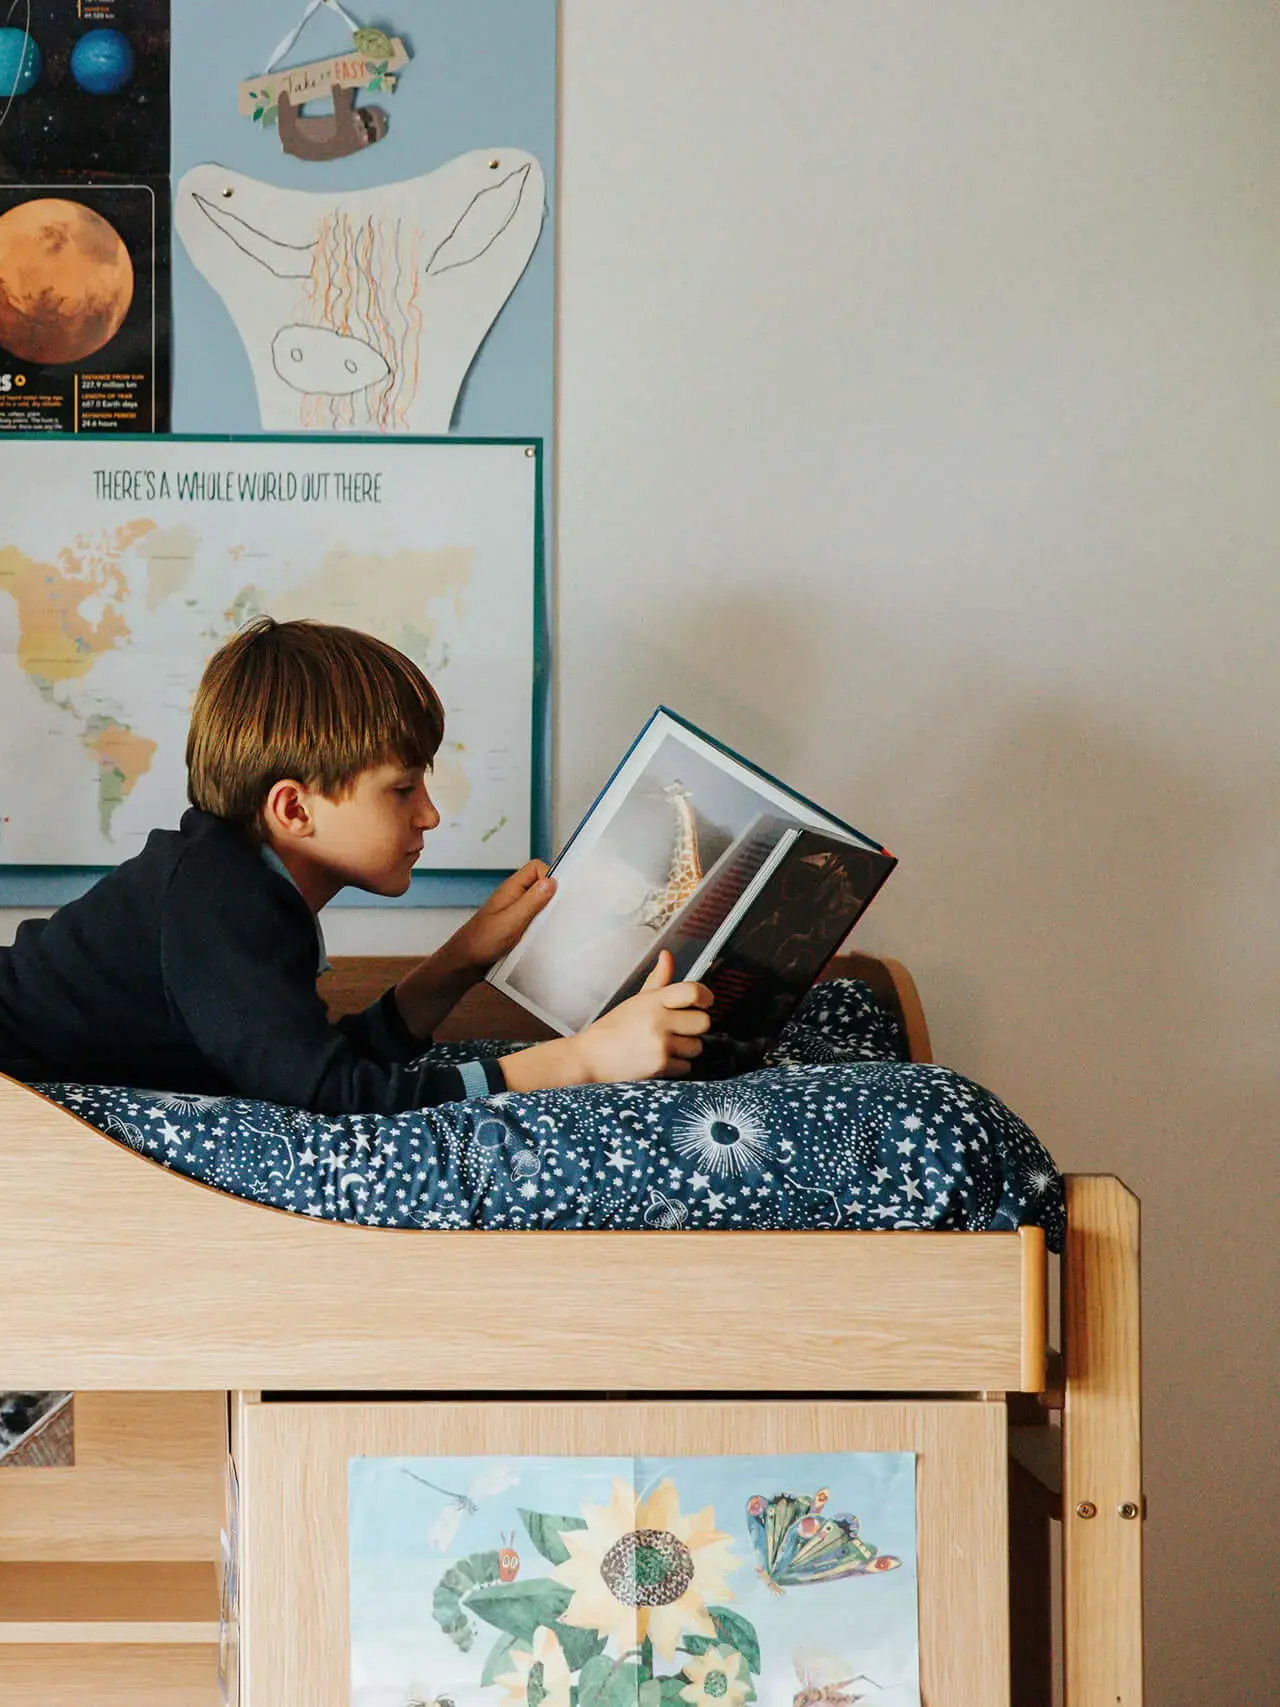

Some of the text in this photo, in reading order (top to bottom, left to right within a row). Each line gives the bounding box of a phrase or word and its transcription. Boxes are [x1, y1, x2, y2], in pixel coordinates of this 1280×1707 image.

[282, 71, 317, 93] Take
[334, 58, 365, 81] EASY
[102, 401, 120, 409] Earth
[122, 401, 138, 409] days
[98, 420, 118, 428] hours
[93, 469, 382, 503] THERE'S A WHOLE WORLD OUT THERE
